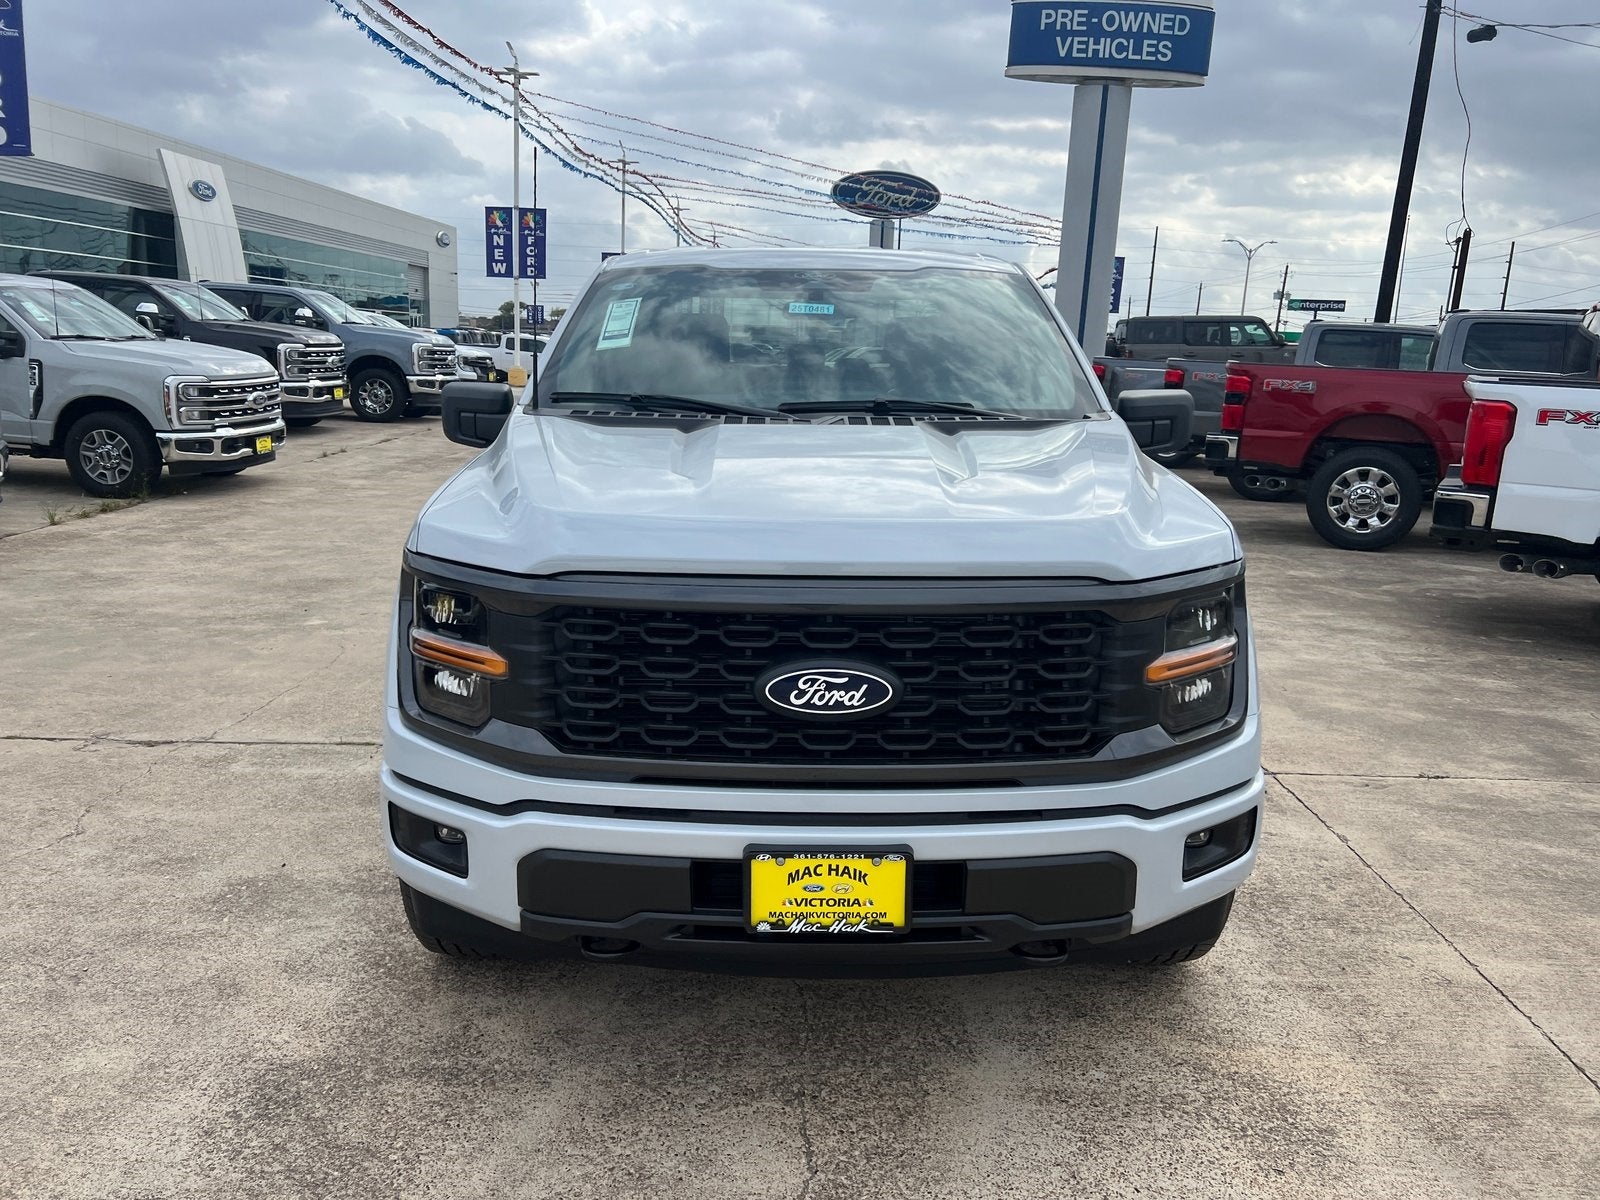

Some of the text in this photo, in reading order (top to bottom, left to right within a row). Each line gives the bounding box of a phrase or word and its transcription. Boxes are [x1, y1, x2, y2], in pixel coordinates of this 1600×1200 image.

[1056, 36, 1173, 62] VEHICLES
[197, 182, 213, 197] Ford
[855, 177, 917, 207] Ford
[492, 234, 507, 274] NEW
[526, 236, 538, 276] FORD
[1290, 301, 1345, 310] enterprise
[1263, 378, 1316, 392] FX4
[1536, 408, 1600, 426] FX
[789, 675, 868, 706] Ford
[787, 863, 869, 886] MAC HAIK
[794, 897, 862, 908] VICTORIA
[768, 911, 888, 919] MACHAIKVICTORIA.COM
[787, 917, 870, 934] Mac Haik
